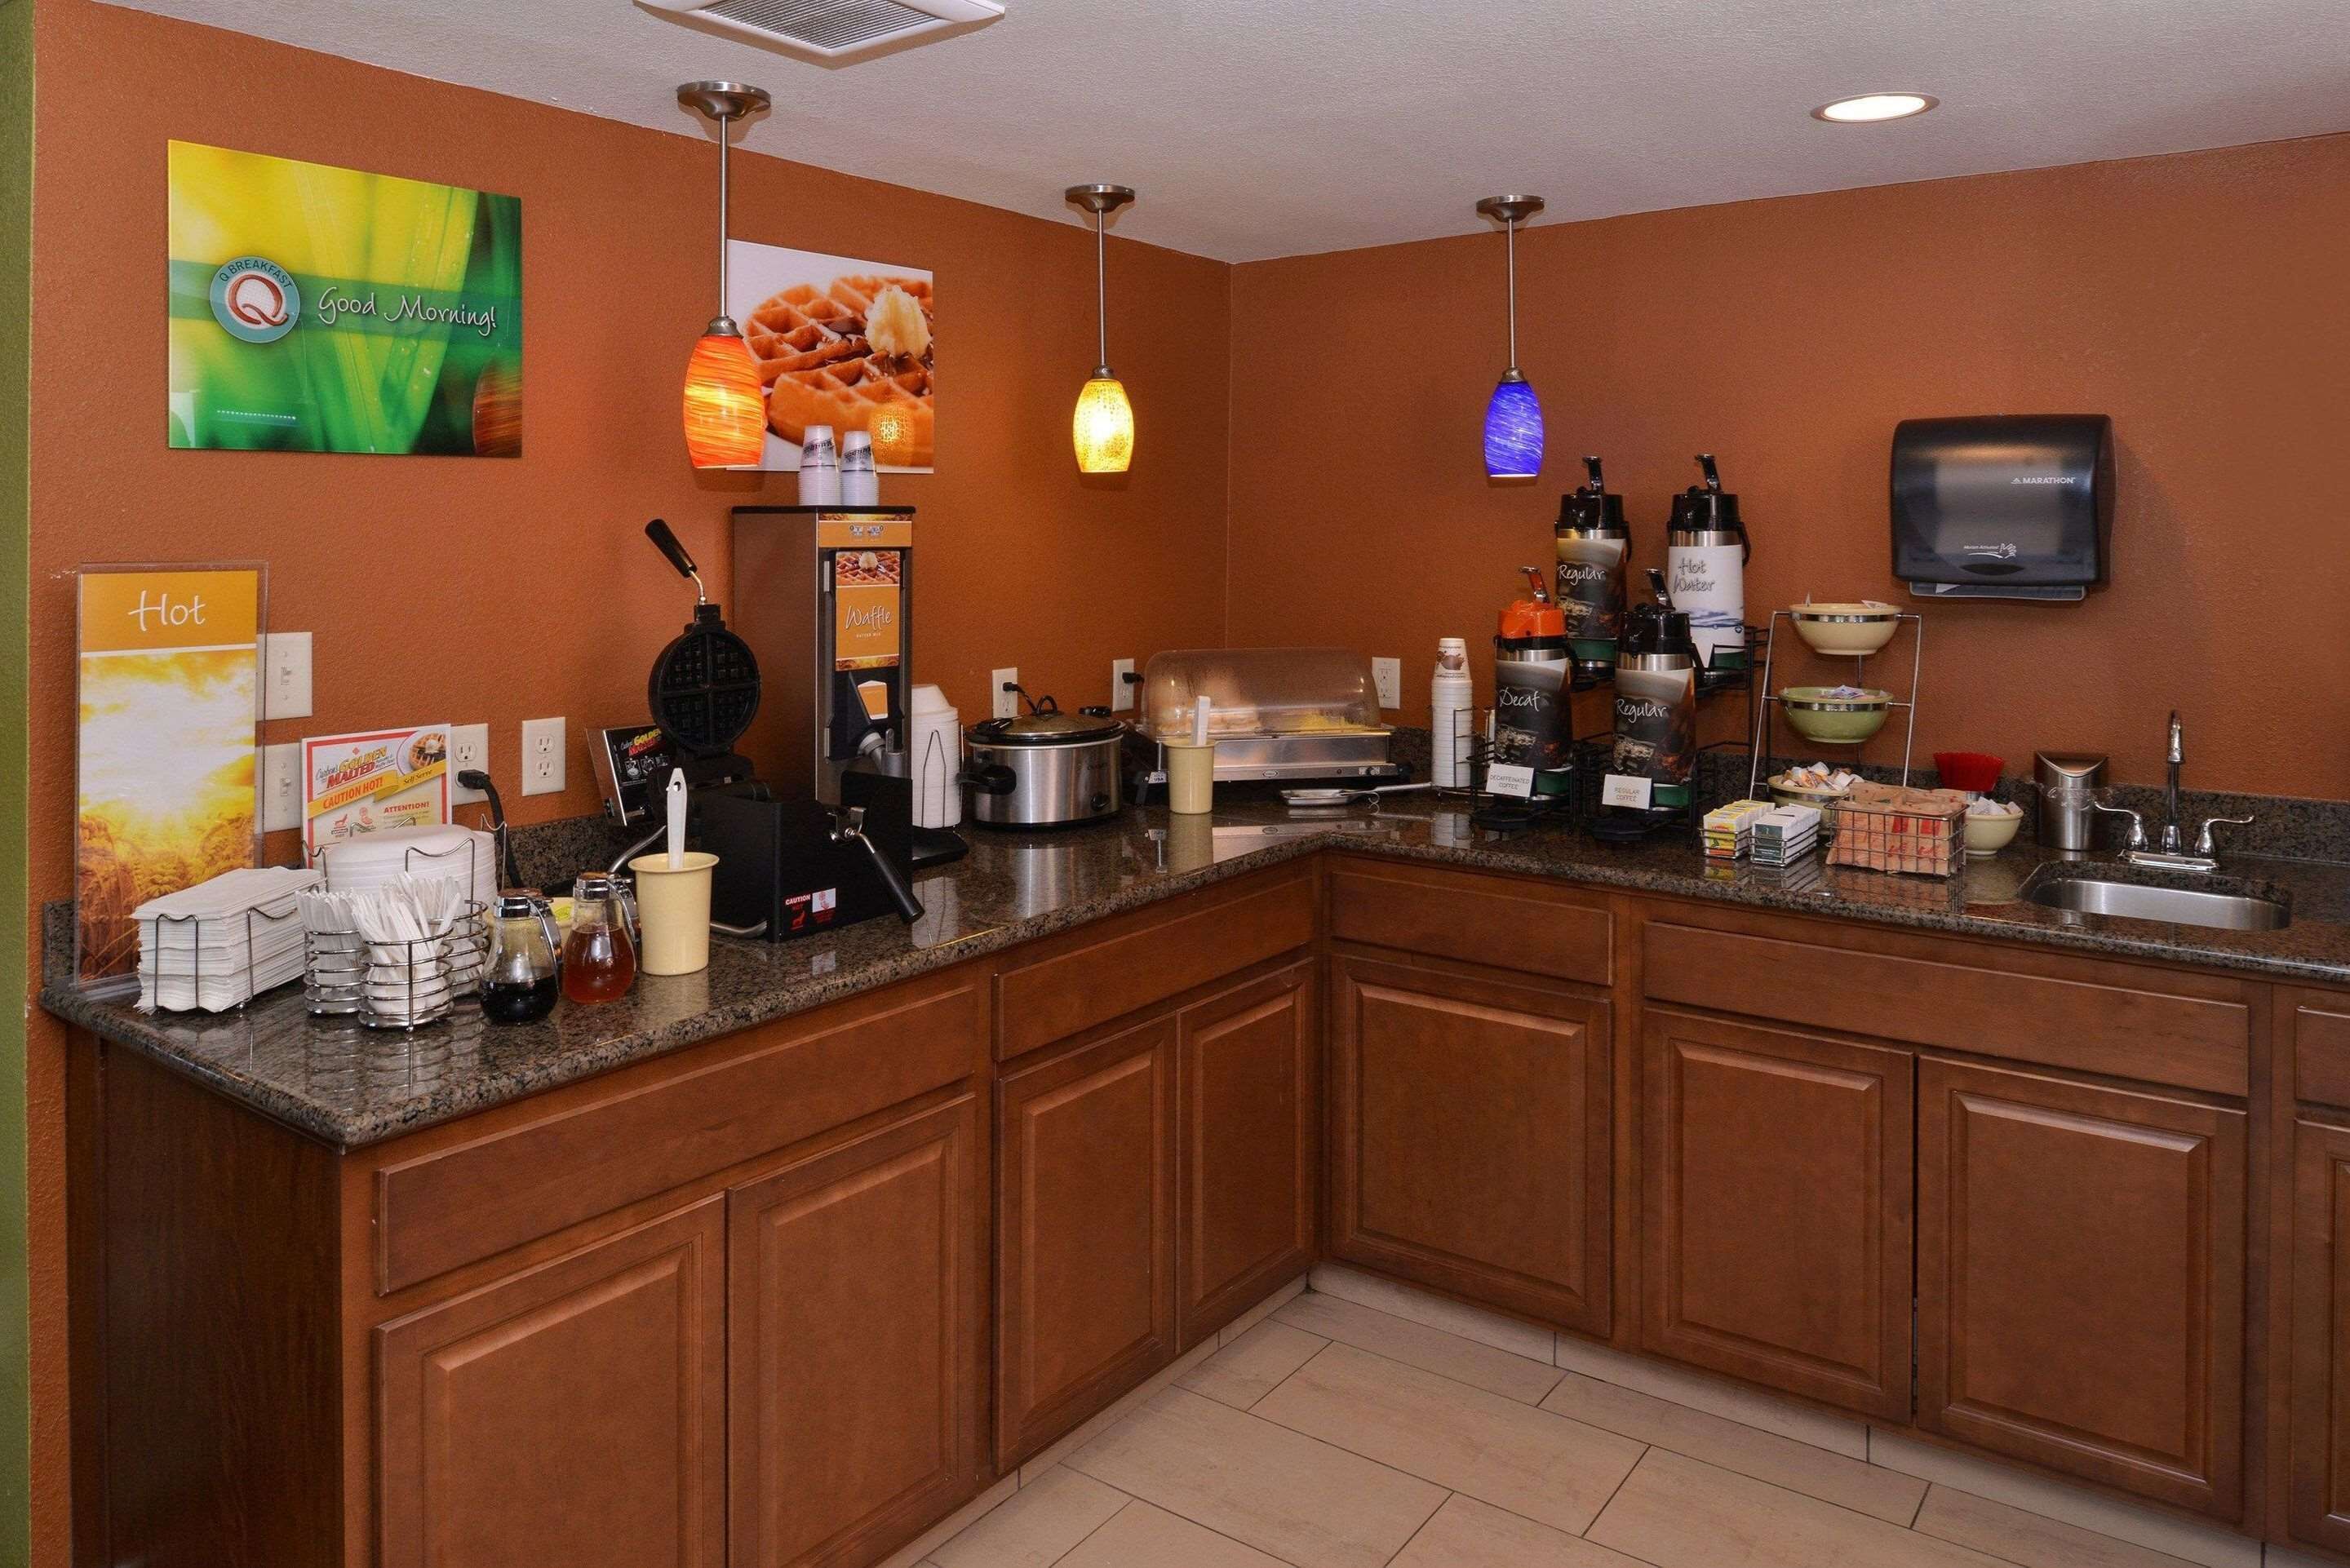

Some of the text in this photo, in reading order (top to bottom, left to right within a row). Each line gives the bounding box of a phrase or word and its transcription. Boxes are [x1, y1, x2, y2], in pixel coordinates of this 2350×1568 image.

[219, 259, 293, 288] Q BREAKFAST
[228, 273, 288, 326] Q
[317, 286, 497, 337] Good Morning!
[2022, 476, 2075, 485] MARATHON
[1557, 564, 1606, 587] Regular
[1678, 557, 1707, 575] Hot
[1673, 574, 1715, 594] Water
[127, 589, 206, 632] Hot
[845, 605, 892, 631] Waffle
[1499, 687, 1541, 711] Decaf
[1615, 698, 1667, 724] Regular
[326, 761, 376, 788] MALTED
[404, 769, 432, 785] Self Serve
[322, 777, 384, 809] CAUTION HOT!
[384, 801, 430, 814] ATTENTION!
[785, 894, 811, 906] CAUTION
